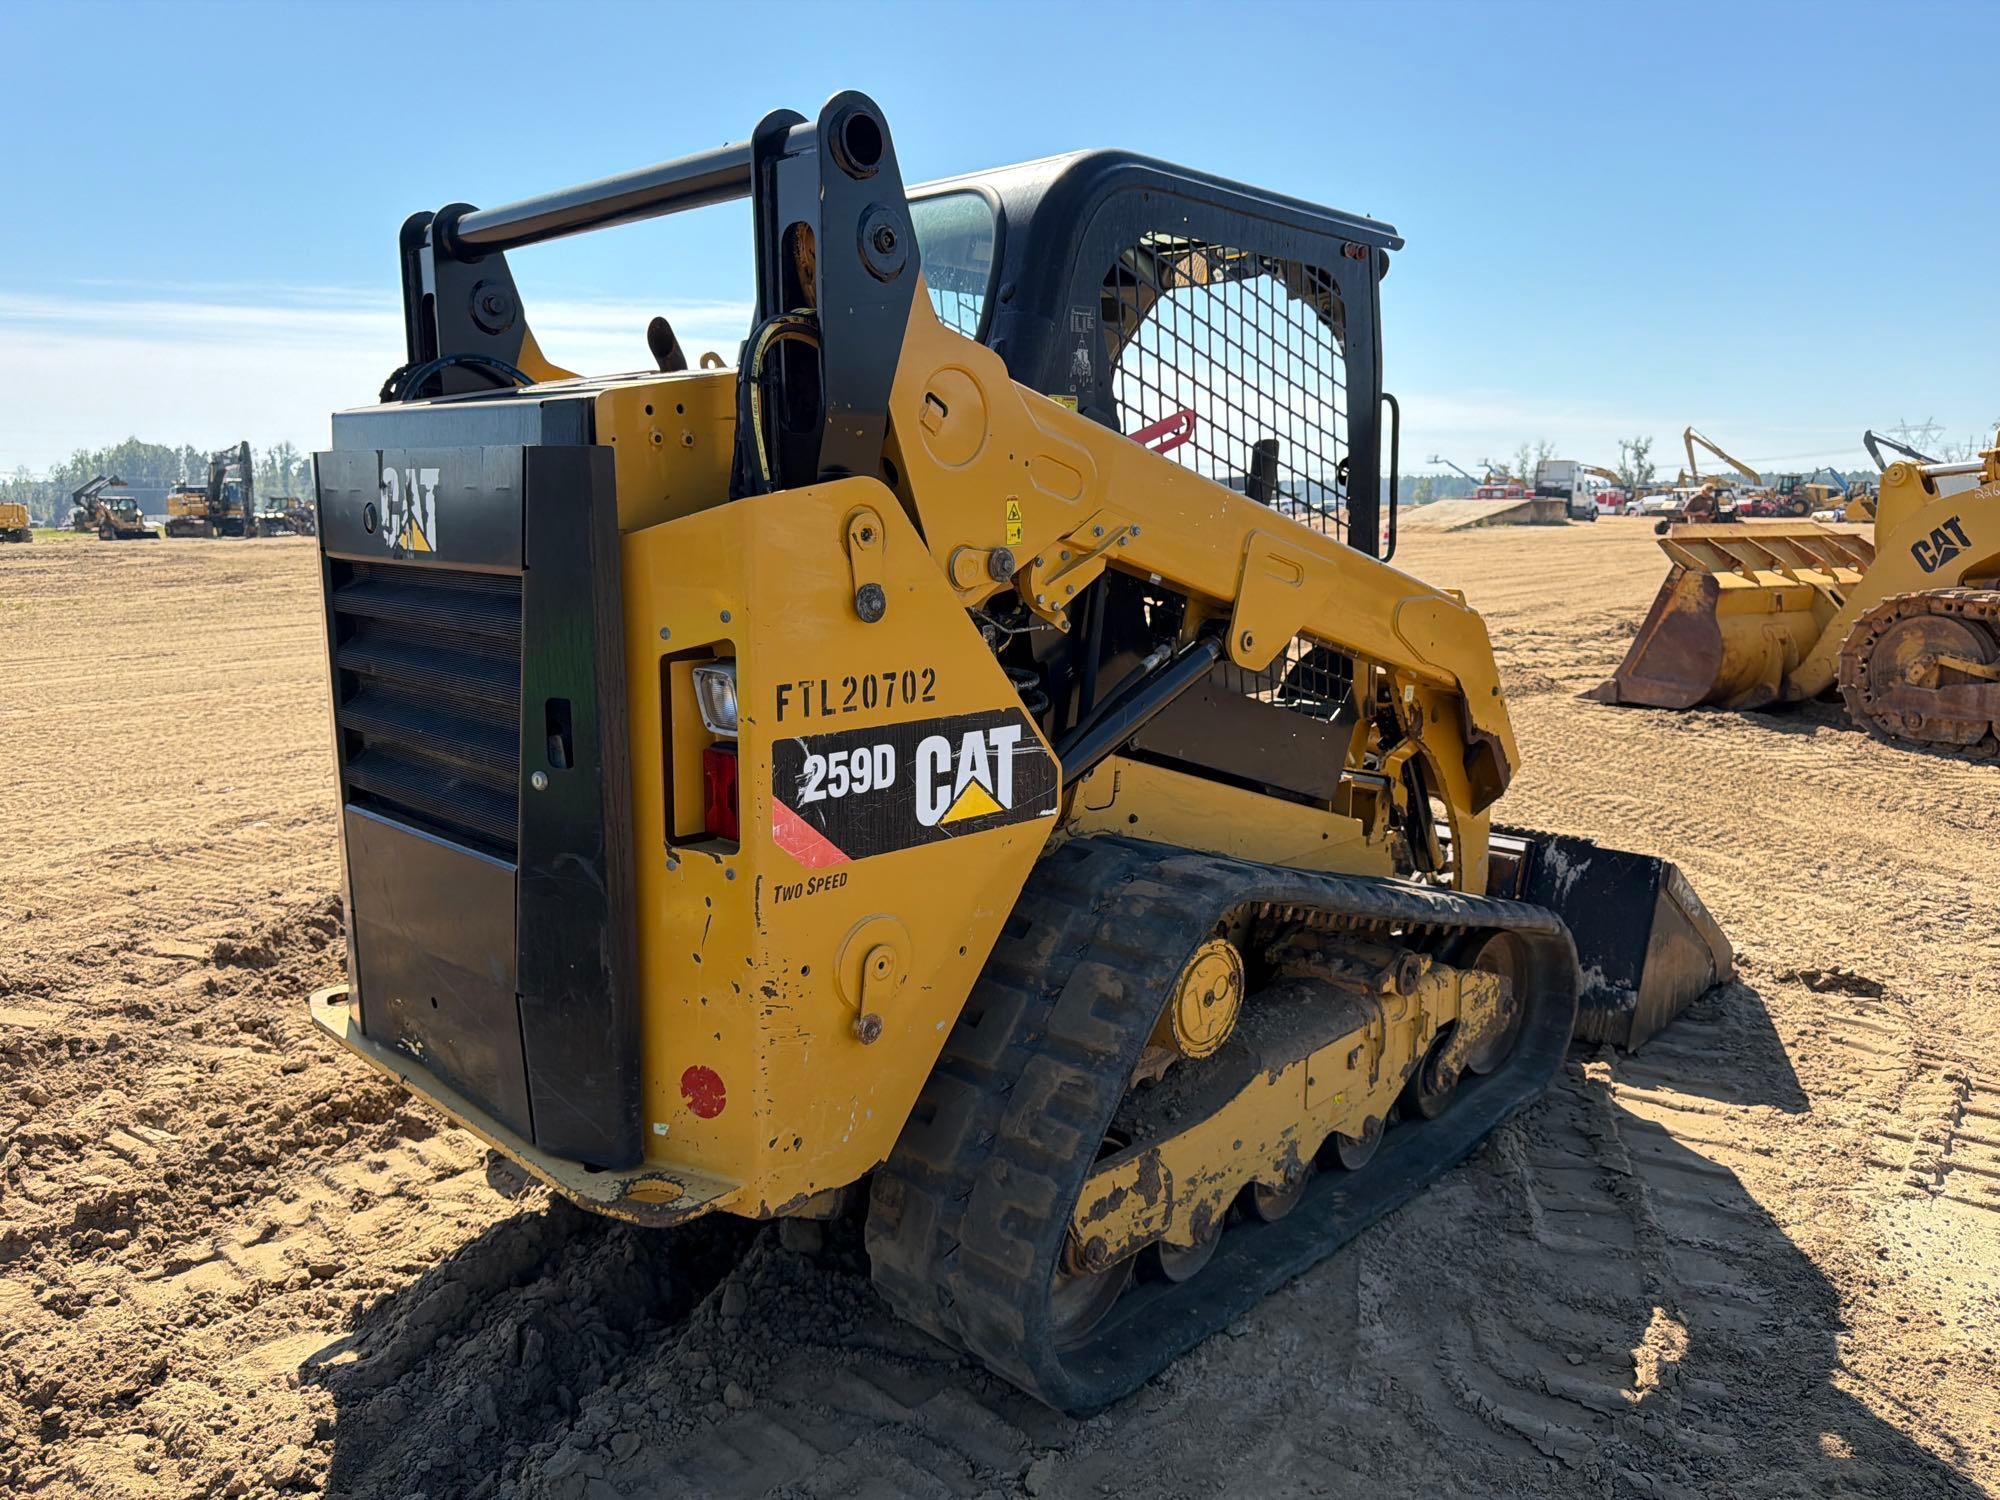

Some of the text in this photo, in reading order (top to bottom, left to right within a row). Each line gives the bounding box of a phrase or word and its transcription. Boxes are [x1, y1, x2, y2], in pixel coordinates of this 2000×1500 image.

[380, 467, 440, 553] CAT
[1911, 514, 1972, 573] CAT
[776, 667, 936, 722] FTL20702
[801, 724, 1022, 827] 259D CAT
